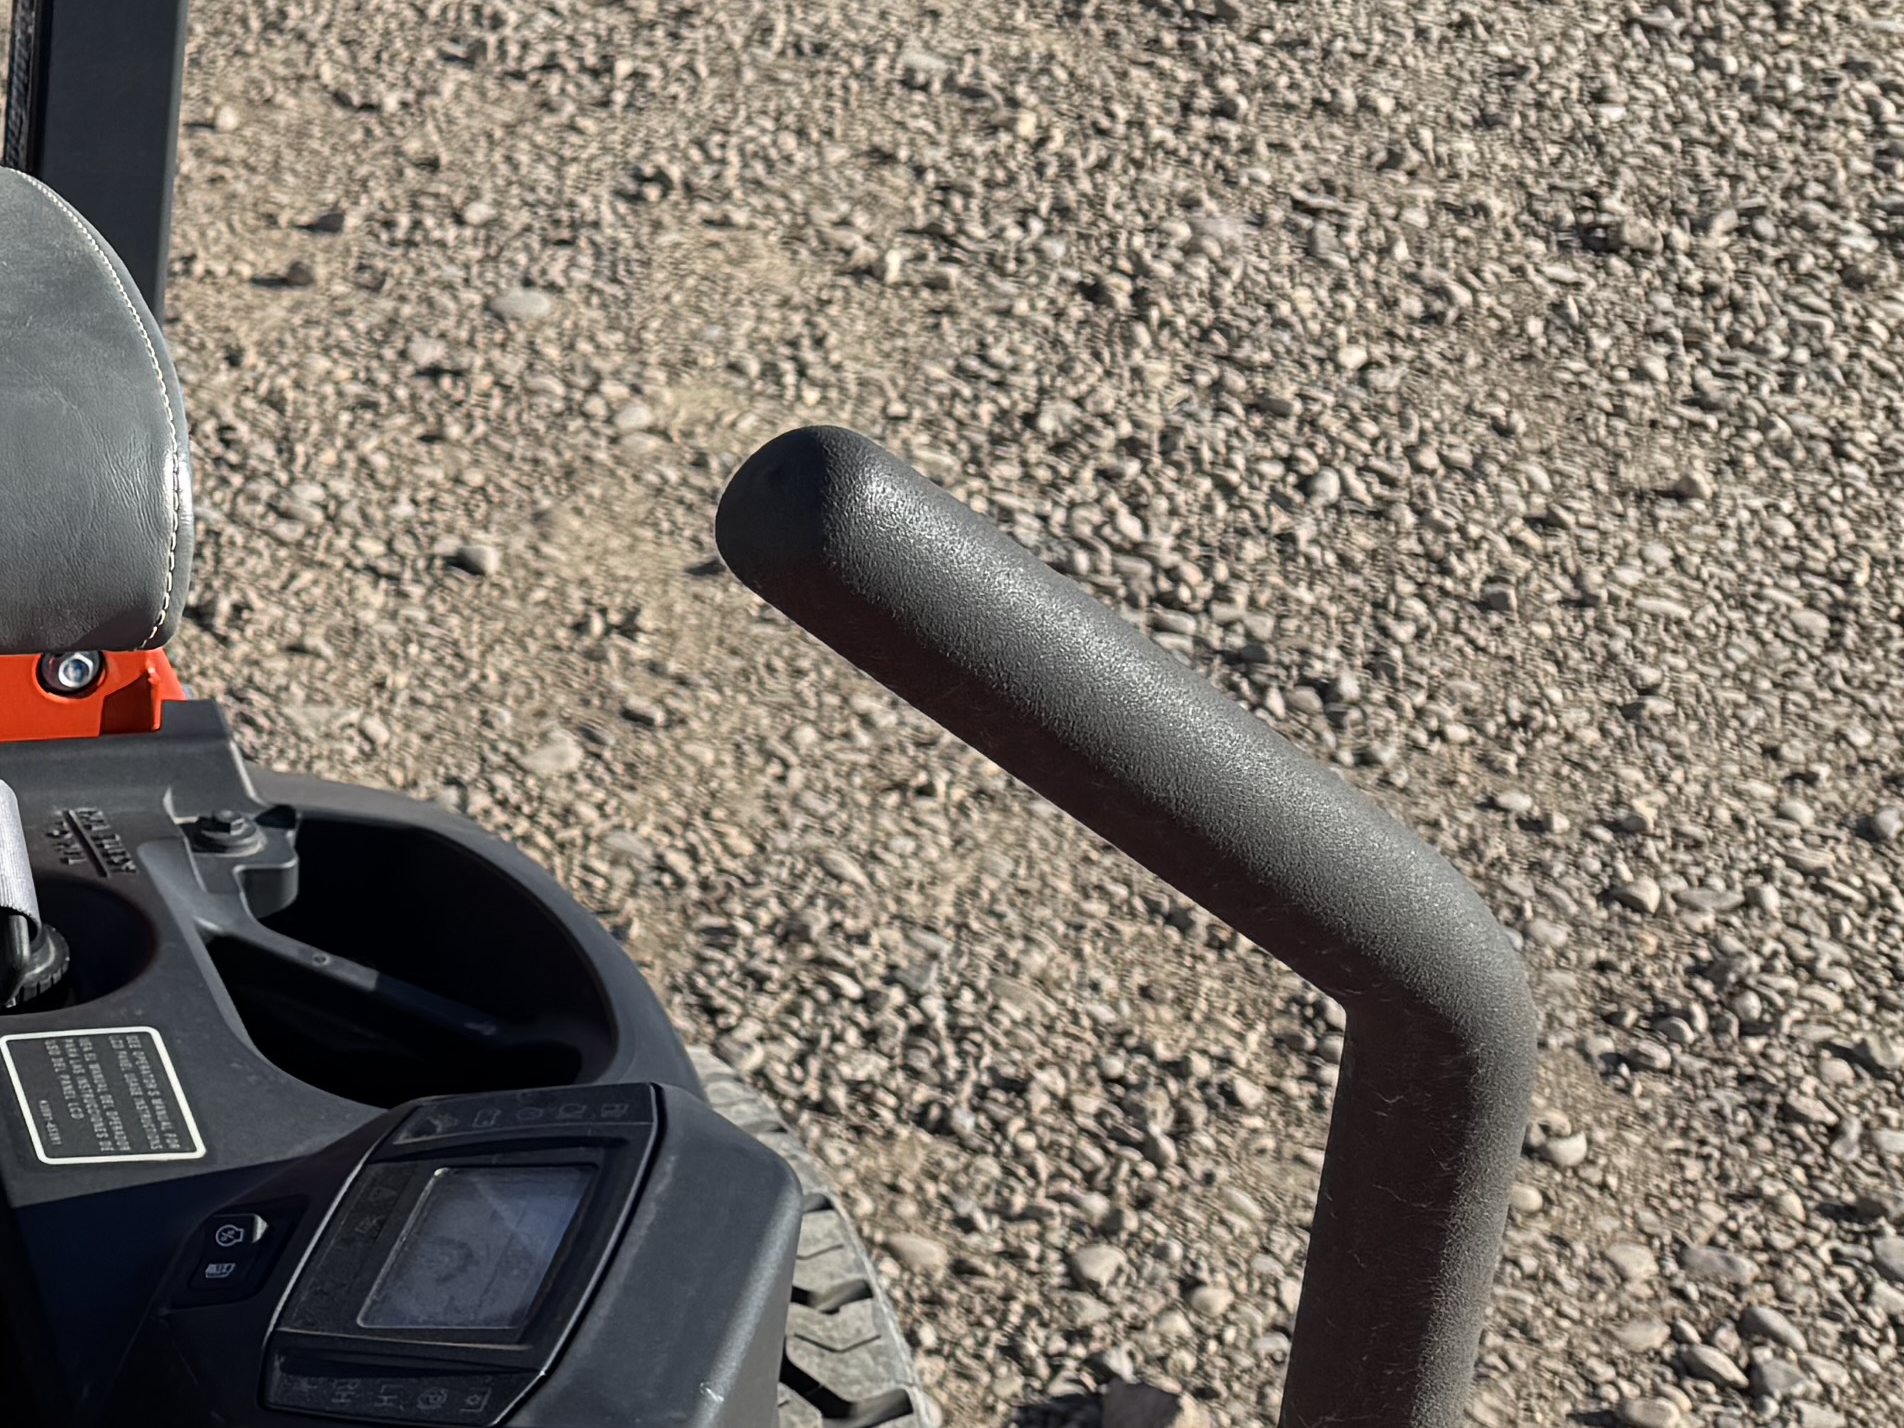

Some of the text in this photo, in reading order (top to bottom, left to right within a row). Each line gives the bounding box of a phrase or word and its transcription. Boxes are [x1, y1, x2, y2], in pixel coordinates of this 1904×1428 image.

[49, 1057, 67, 1072] DEL
[65, 1102, 84, 1119] LCD
[68, 1058, 86, 1074] LAS
[97, 1140, 114, 1151] DE
[161, 1132, 179, 1149] FOR
